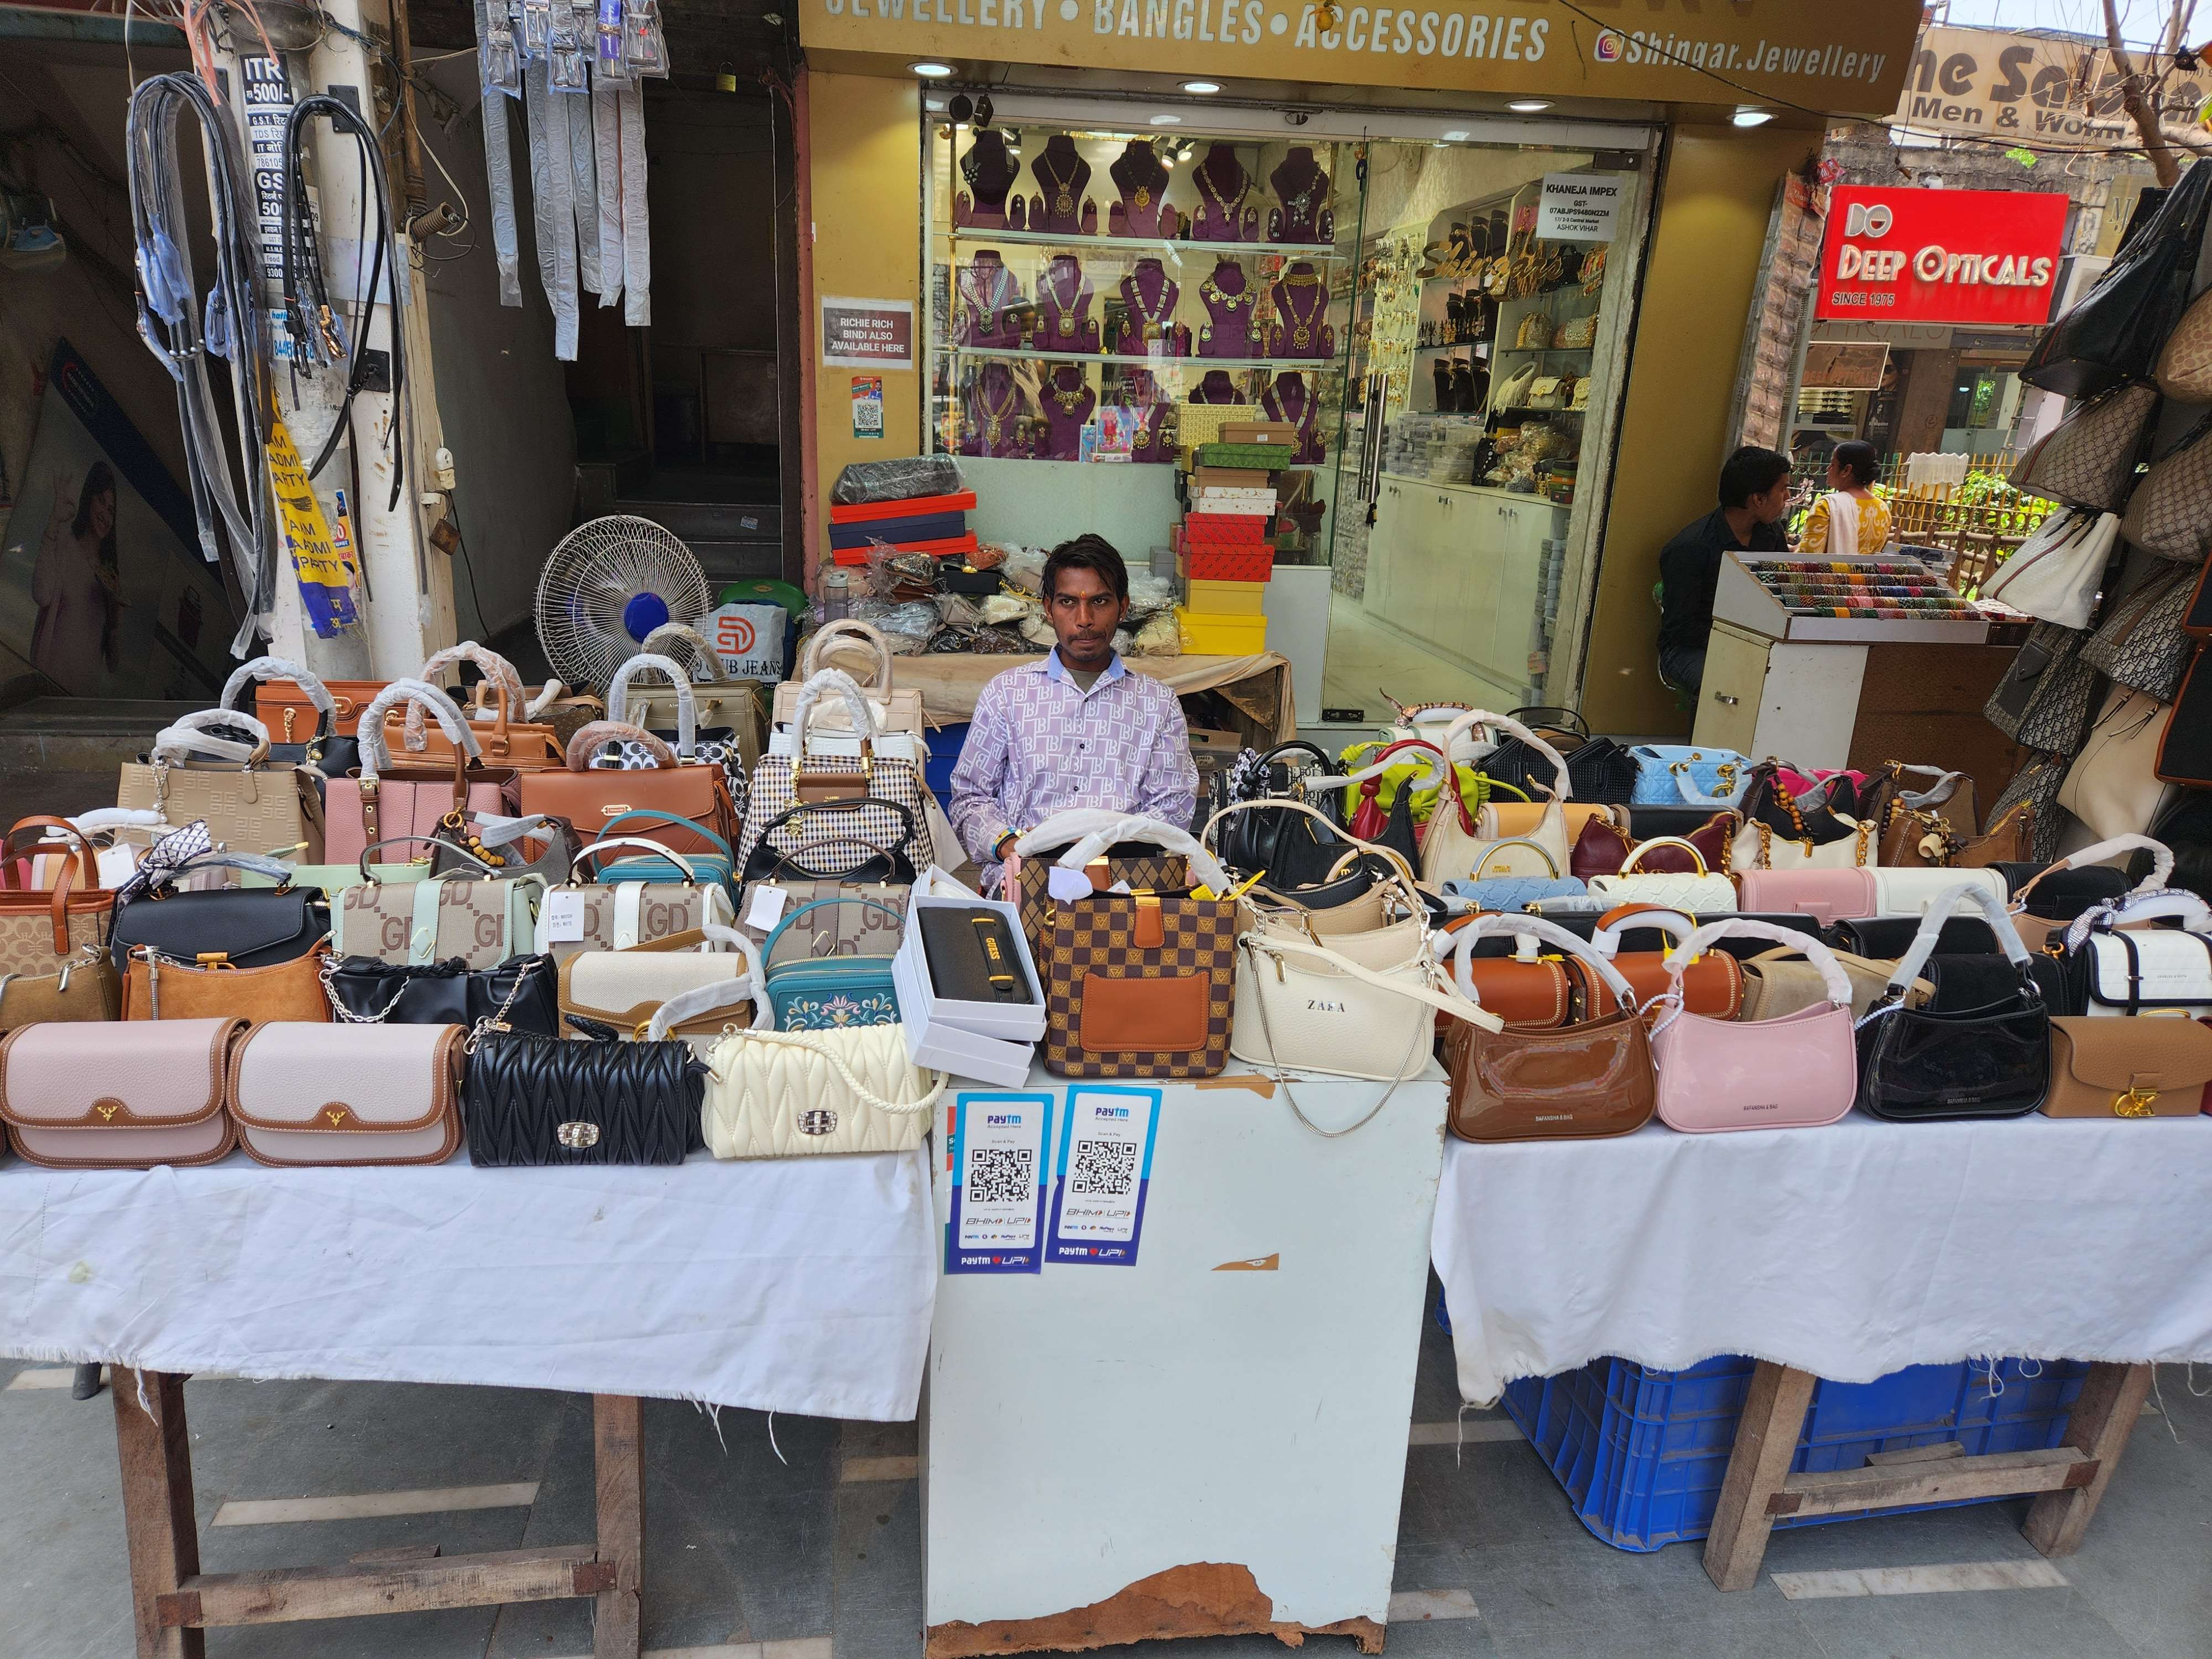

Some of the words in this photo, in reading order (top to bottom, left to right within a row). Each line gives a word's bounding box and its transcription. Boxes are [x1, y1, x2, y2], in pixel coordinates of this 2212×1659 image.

[1093, 0, 1263, 45] BANGLES
[1294, 3, 1550, 62] ACCESSORIES
[1626, 31, 1886, 83] Shingar.Jewellery
[244, 58, 284, 80] ITR
[1911, 96, 1983, 124] Men
[1995, 106, 2020, 128] &
[254, 130, 269, 138] TDS
[257, 144, 264, 152] IT
[257, 171, 283, 190] GS
[1546, 184, 1587, 195] KHANEJA
[1589, 186, 1618, 197] IMPEX
[1836, 244, 1907, 281] DEEP
[1912, 244, 2053, 287] OPTICALS
[1832, 291, 1866, 306] SINCE
[1869, 293, 1895, 307] 1975
[840, 318, 870, 328] RICHIE
[872, 319, 894, 328] RICH
[843, 330, 867, 340] BINDI
[869, 331, 893, 341] ALSO
[831, 340, 880, 352] AVAILABLE
[881, 344, 905, 353] HERE
[742, 660, 782, 675] JEANS
[647, 902, 688, 936] GD
[862, 897, 901, 930] GD
[986, 937, 1000, 959] GUESS
[1307, 999, 1345, 1013] ZARA
[1098, 1248, 1123, 1257] UPI
[1001, 1256, 1026, 1265] UPI
